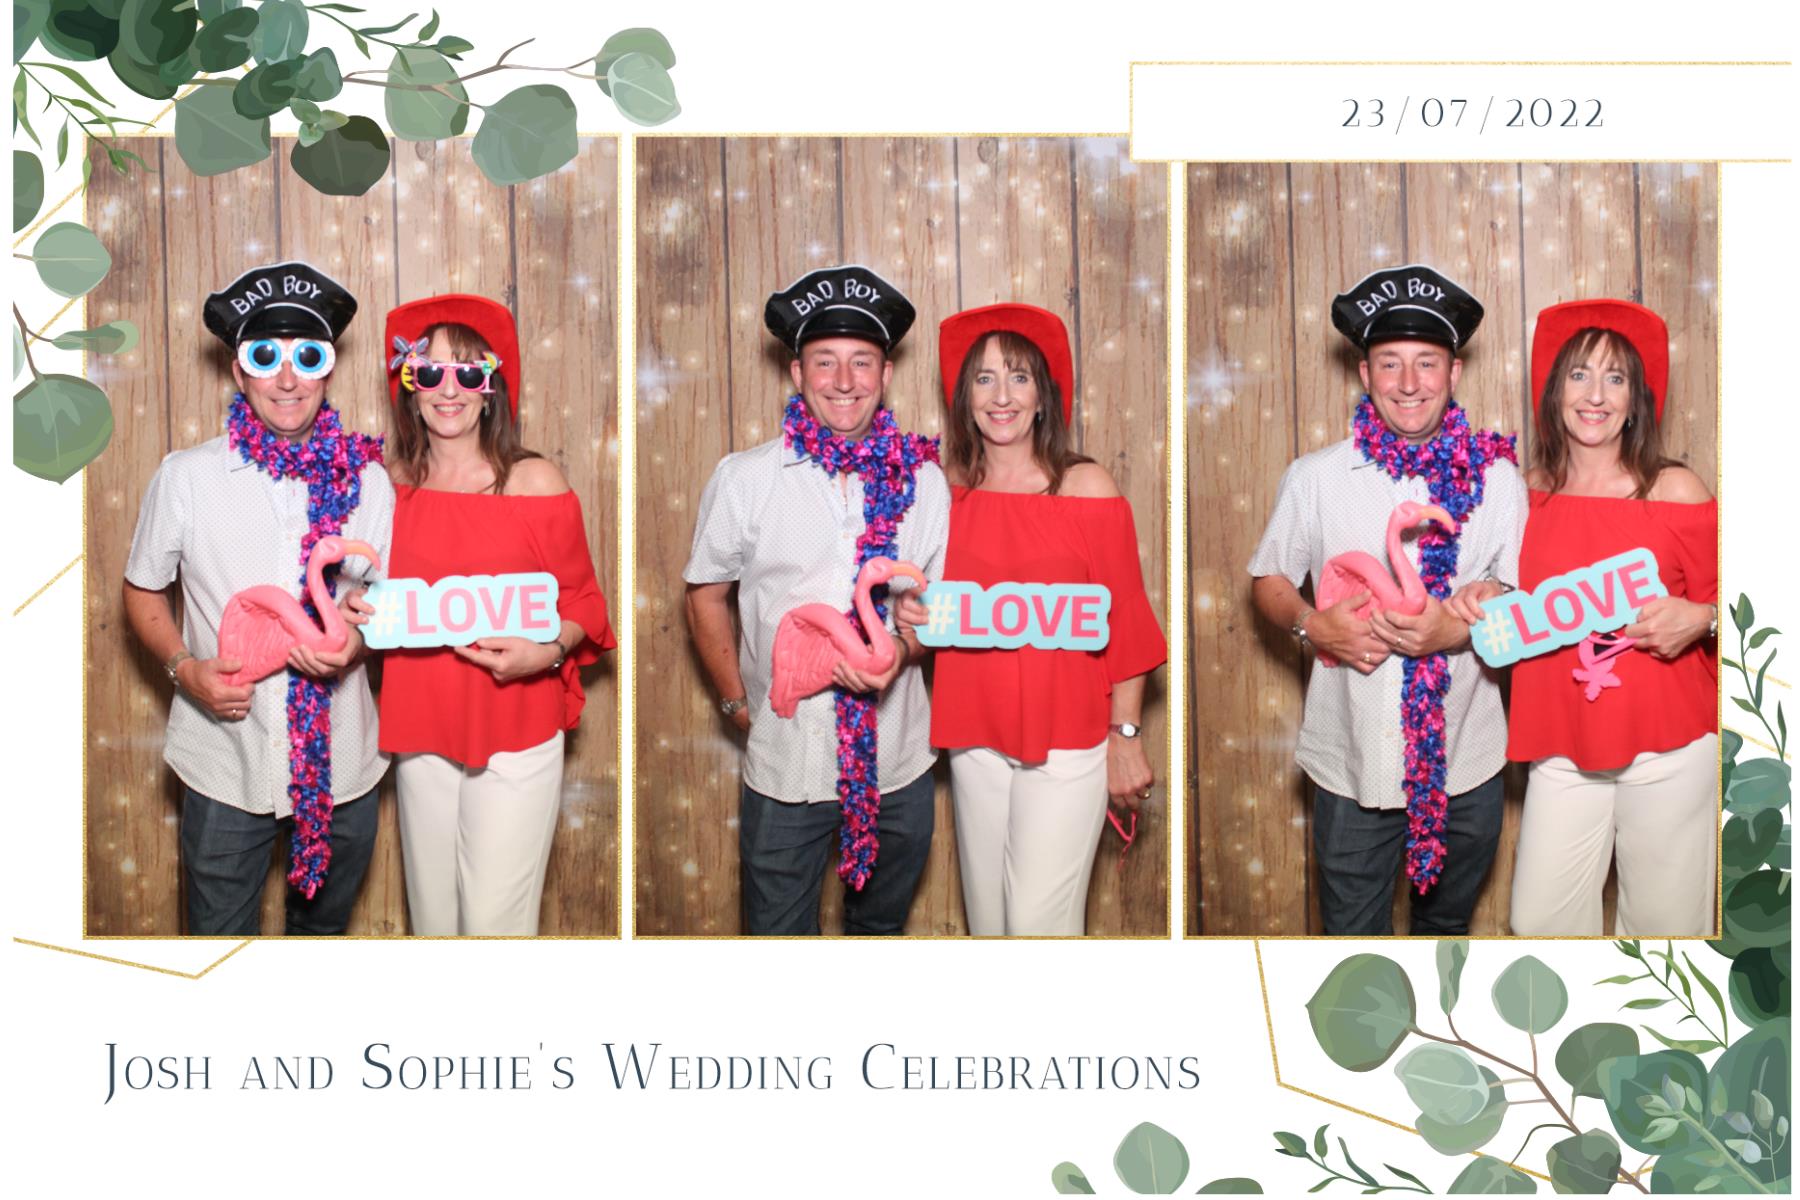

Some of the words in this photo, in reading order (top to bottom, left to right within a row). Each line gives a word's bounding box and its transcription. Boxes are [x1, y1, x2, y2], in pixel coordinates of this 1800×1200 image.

[230, 278, 273, 315] BAD
[283, 275, 322, 299] BOY
[791, 280, 833, 316] BAD
[844, 278, 881, 303] BOY
[1356, 280, 1397, 316] BAD
[1408, 278, 1445, 301] BOY
[374, 584, 550, 636] #LOVE
[927, 593, 1101, 638] #LOVE
[1482, 560, 1658, 656] #LOVE
